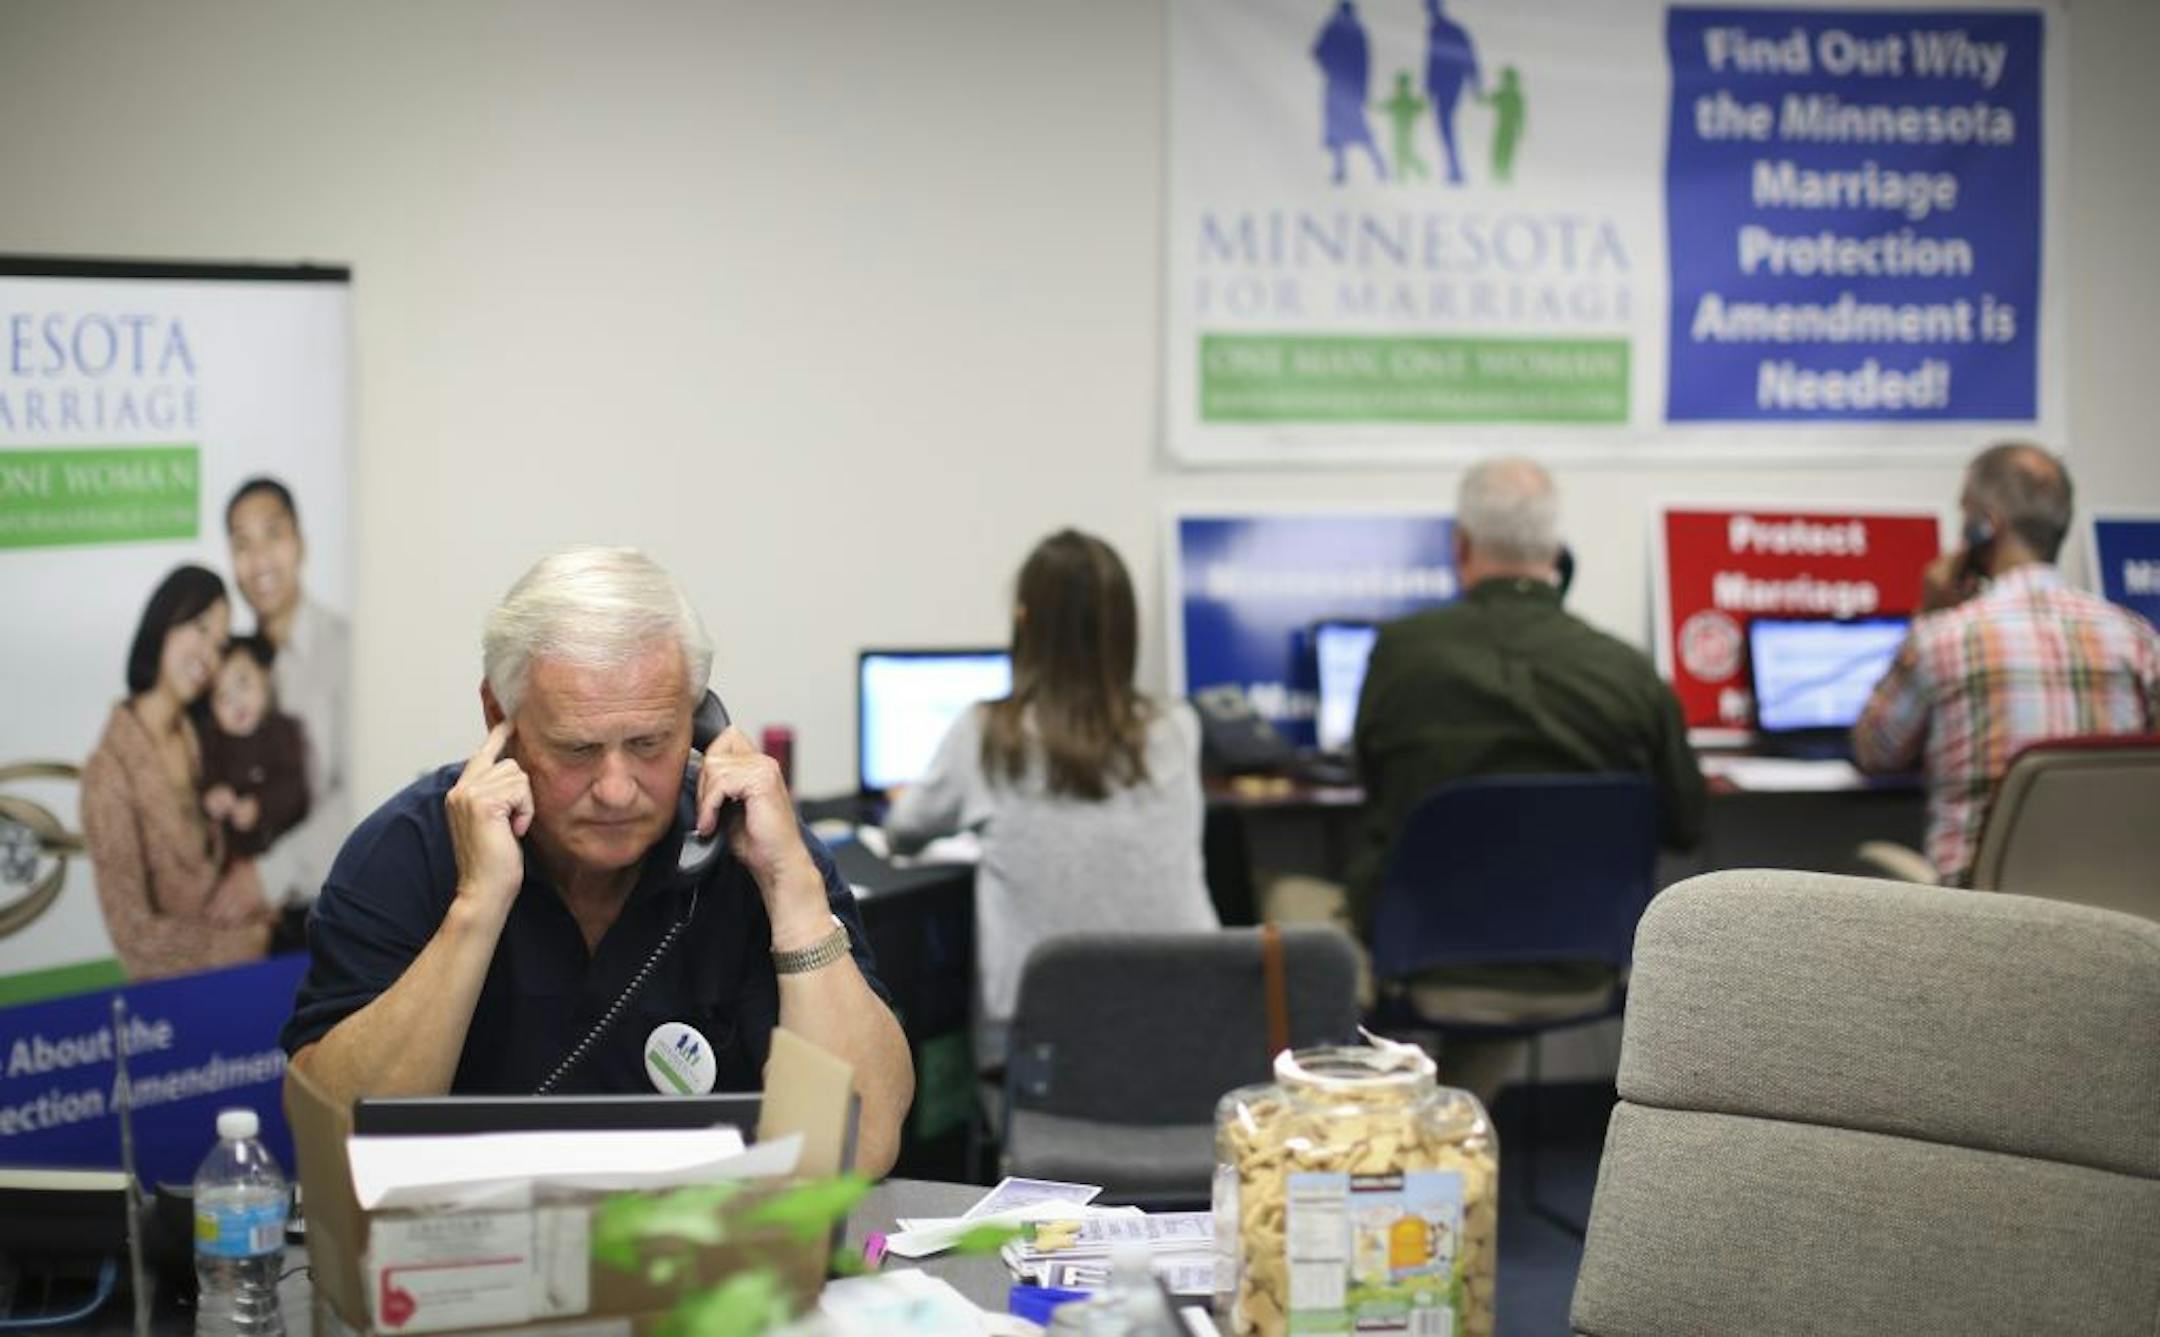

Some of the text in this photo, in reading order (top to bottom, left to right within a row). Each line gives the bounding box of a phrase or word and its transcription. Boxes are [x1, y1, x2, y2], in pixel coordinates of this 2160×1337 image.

[1703, 26, 2008, 88] Find Out Why
[1695, 92, 2016, 144] the Minnesota
[1751, 160, 1959, 220] Marriage
[1200, 210, 1632, 274] MINNESOTA
[1737, 225, 1974, 276] Protection
[1691, 290, 2017, 344] Amendment is
[9, 312, 196, 378] ESOTA
[1757, 358, 1951, 410] Needed!
[1727, 515, 1867, 556] Protect
[1713, 571, 1879, 619] Marriage
[6, 1027, 113, 1078] About
[115, 1015, 173, 1056] the
